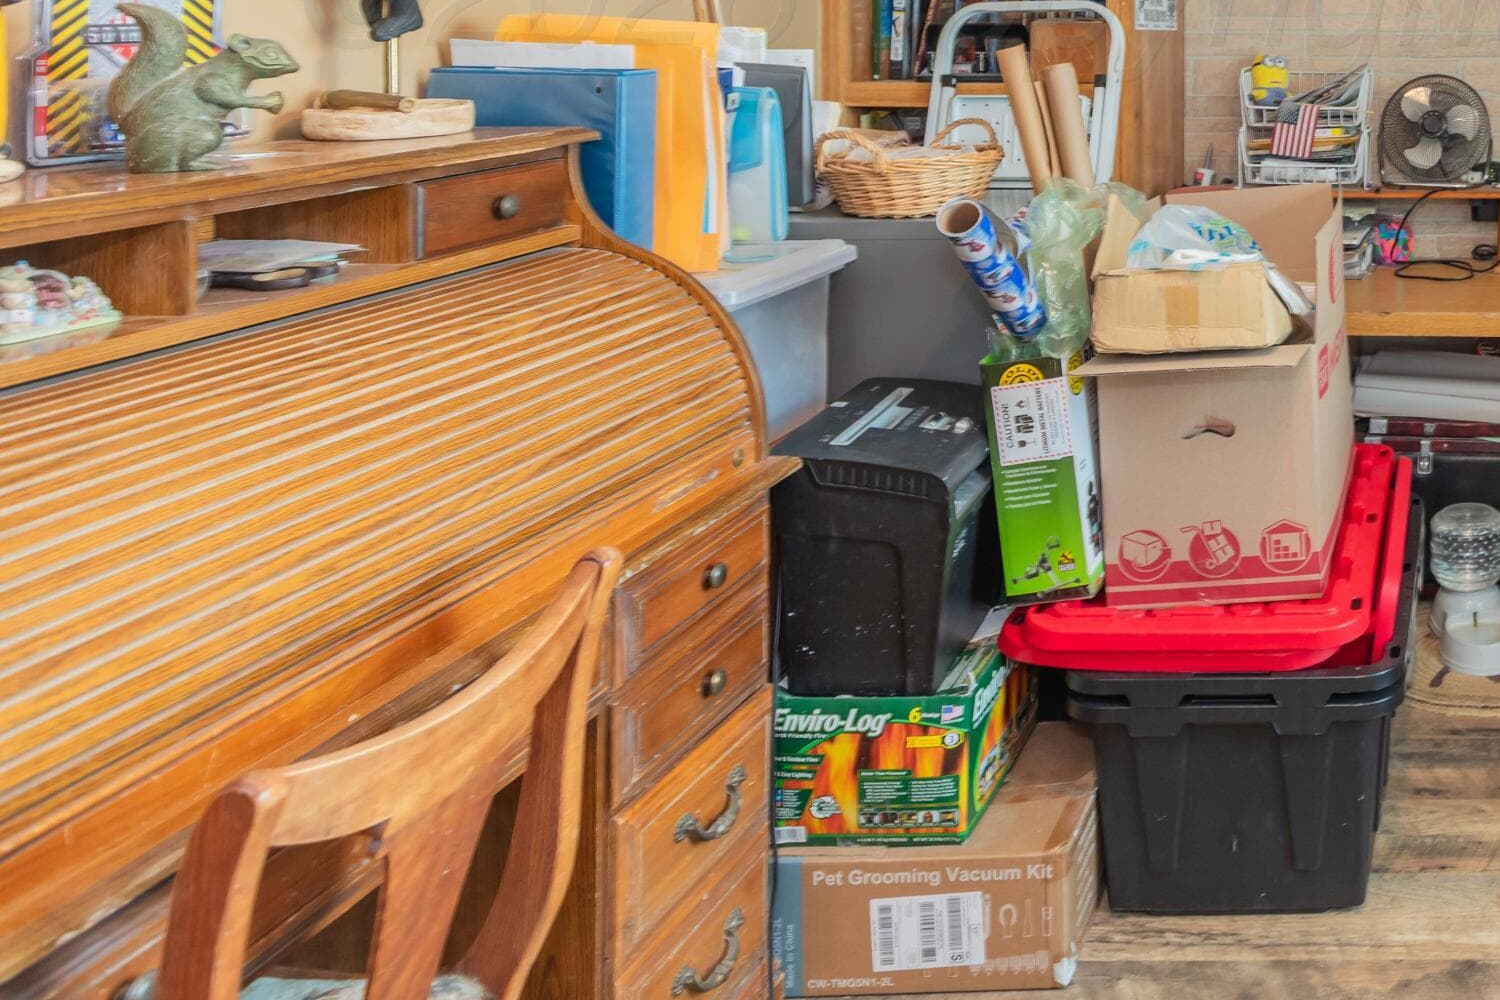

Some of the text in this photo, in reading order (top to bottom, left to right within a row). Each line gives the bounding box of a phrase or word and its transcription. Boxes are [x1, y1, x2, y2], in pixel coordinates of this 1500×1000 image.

[1001, 403, 1014, 449] CAUTION!
[1034, 387, 1049, 455] LITHIUM METAL BATTERY
[774, 708, 893, 738] Enviro-Log
[908, 707, 922, 723] 6
[812, 864, 1054, 887] Pet Grooming Vacuum Kit
[784, 924, 793, 989] Made in China
